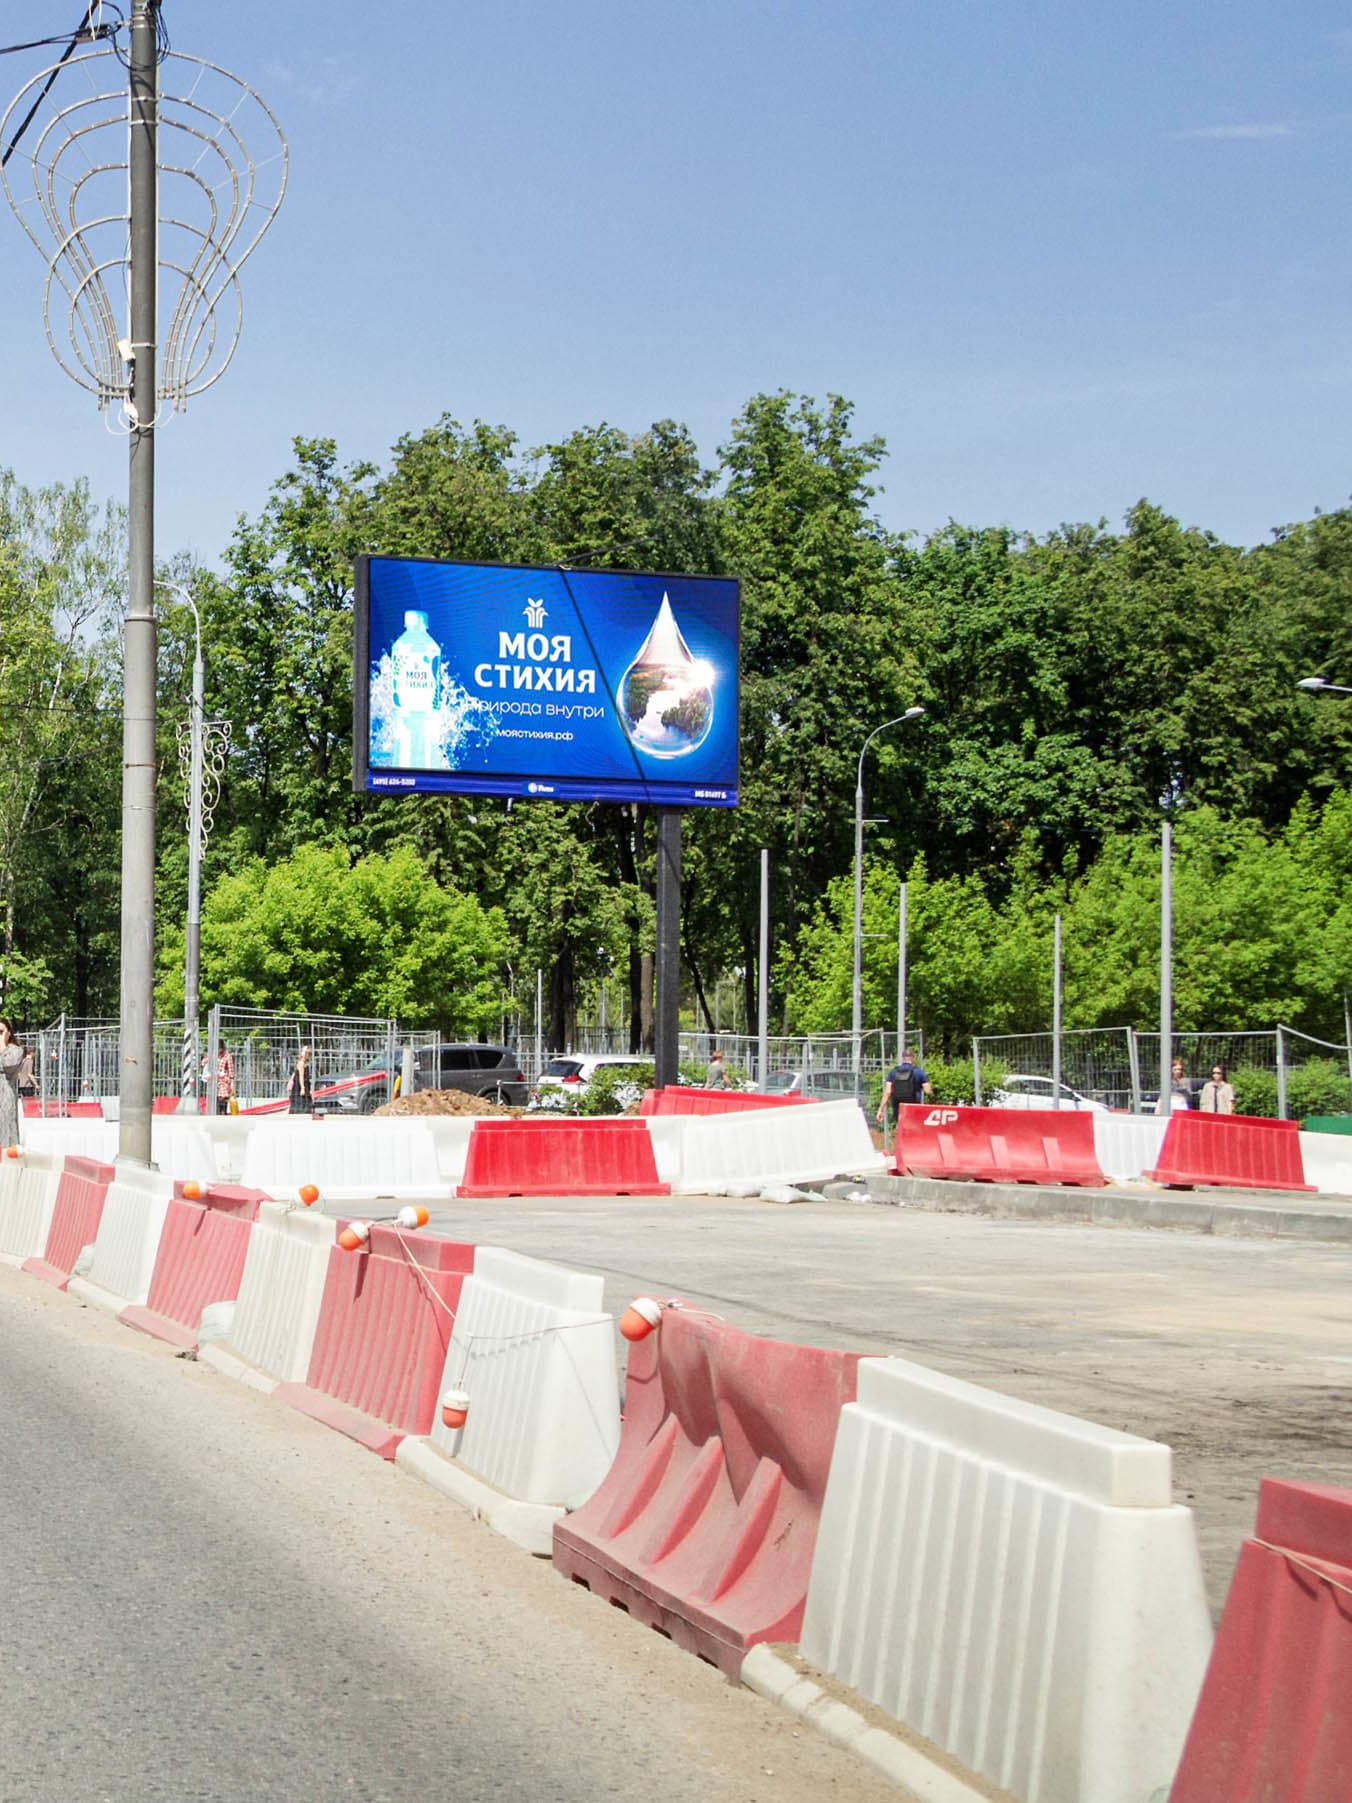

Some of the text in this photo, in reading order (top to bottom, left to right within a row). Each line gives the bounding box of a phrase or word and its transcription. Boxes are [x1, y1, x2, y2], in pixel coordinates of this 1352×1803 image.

[498, 631, 571, 662] МОЯ
[474, 663, 596, 693] СТИХИЯ
[546, 703, 605, 720] внутри
[496, 728, 574, 742] моястихия.рф
